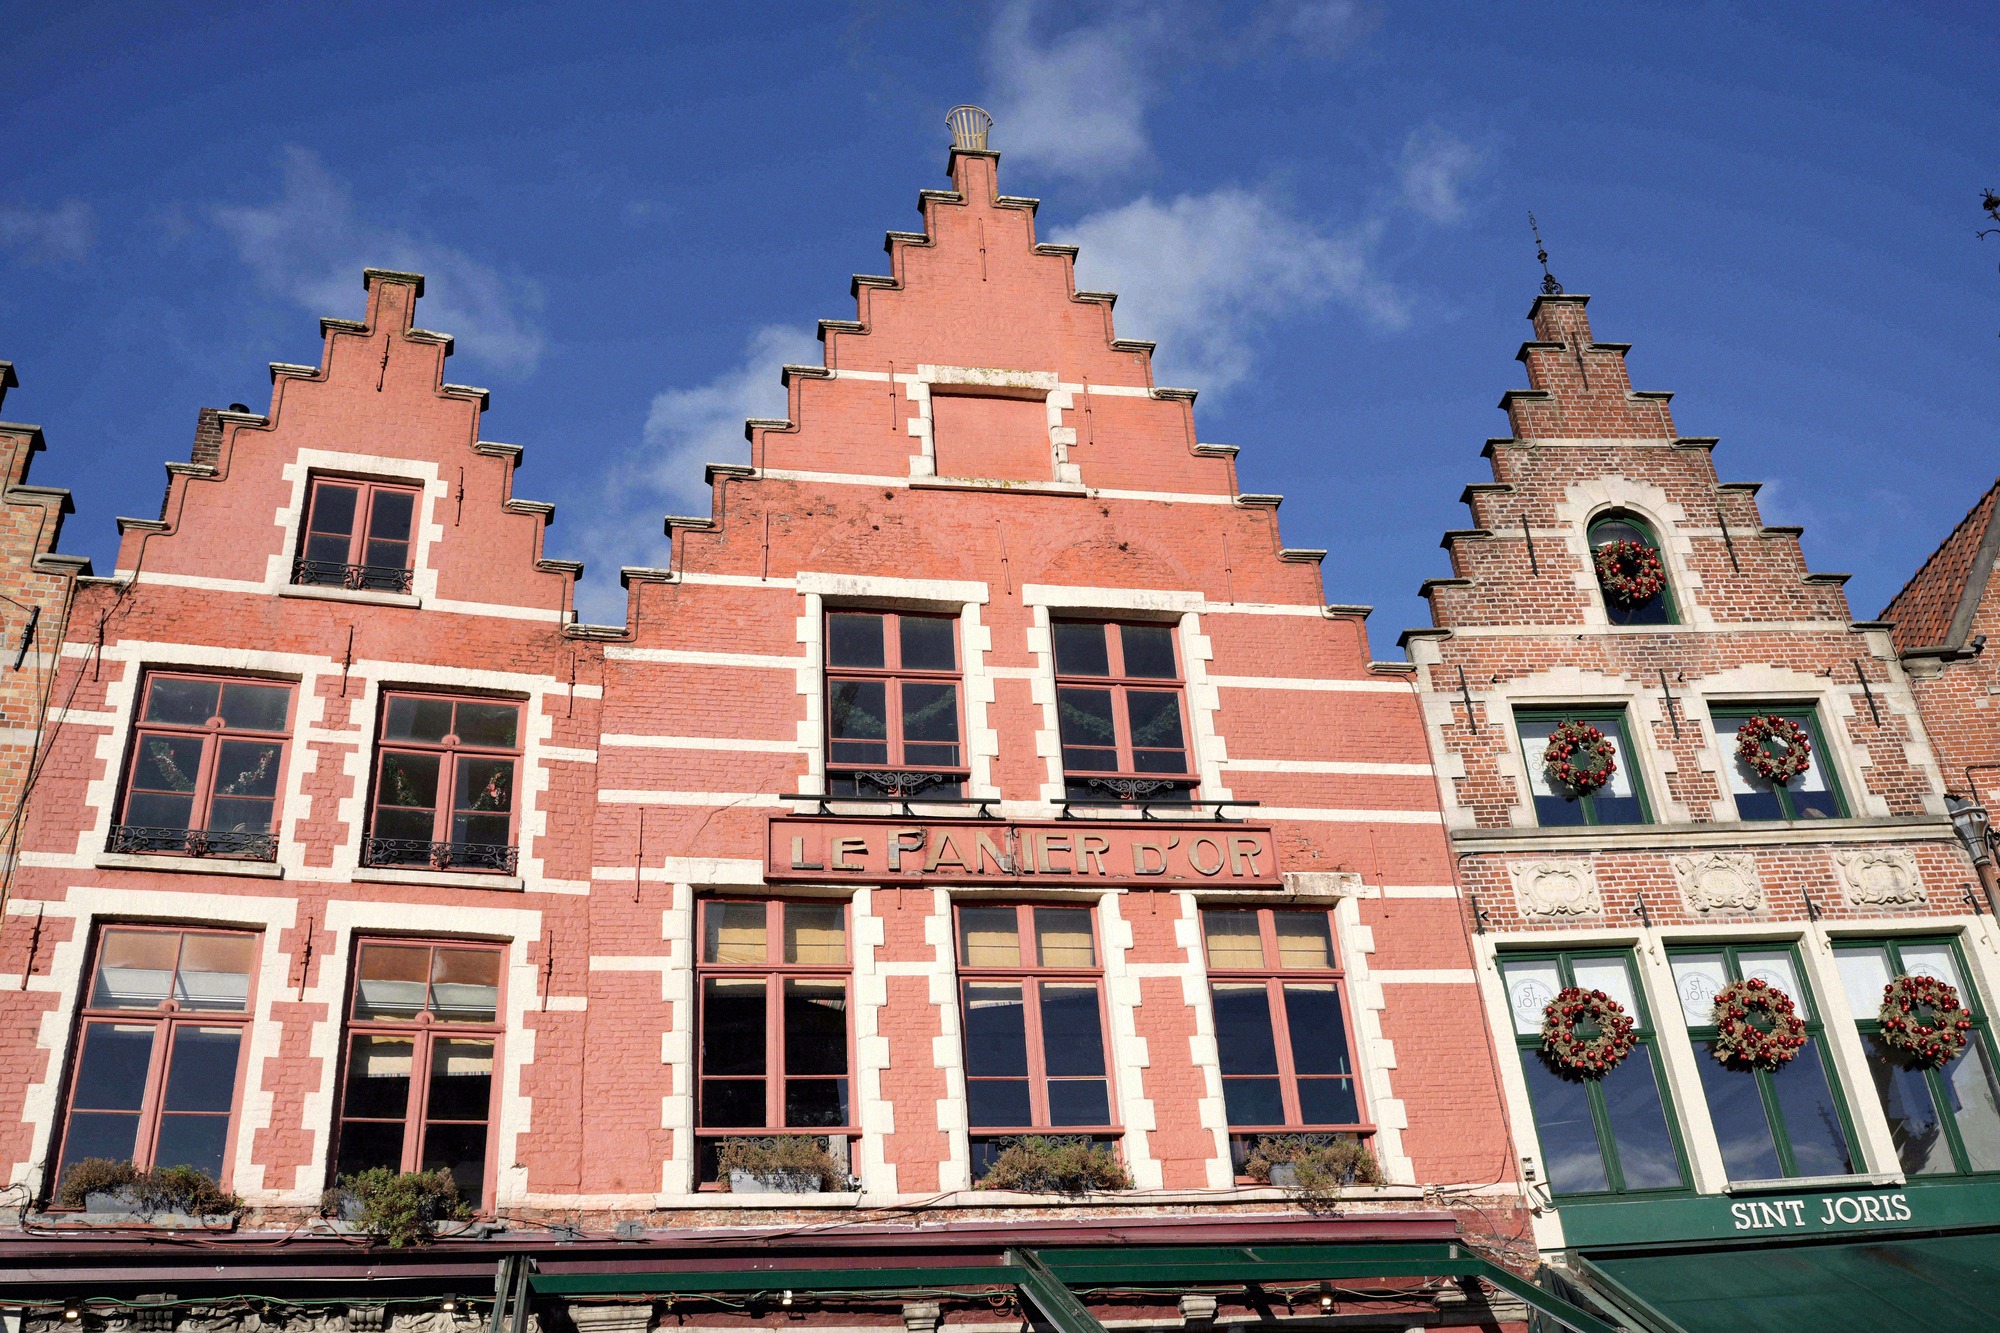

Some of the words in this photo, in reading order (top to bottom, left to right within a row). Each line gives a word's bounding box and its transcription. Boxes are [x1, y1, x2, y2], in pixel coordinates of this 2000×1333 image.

[791, 836, 868, 871] LE
[888, 829, 1109, 875] PANIER
[1131, 834, 1261, 877] D'OR
[1731, 1200, 1805, 1230] SINT
[1820, 1194, 1912, 1225] JORIS
